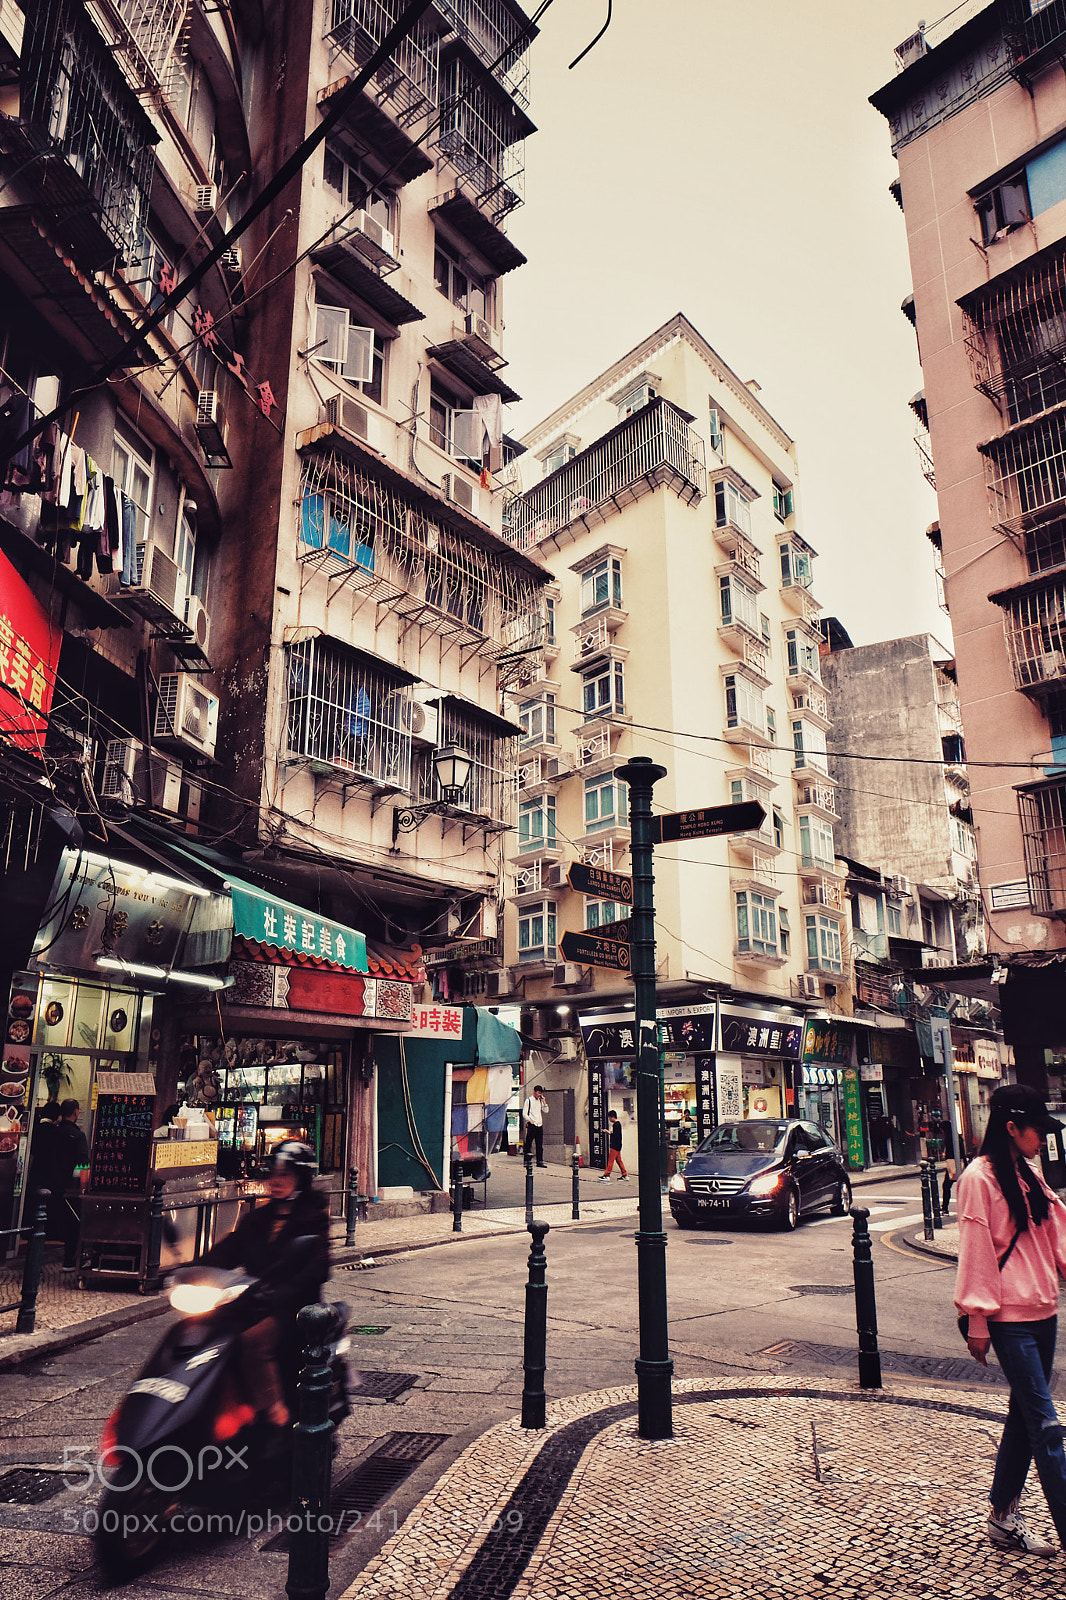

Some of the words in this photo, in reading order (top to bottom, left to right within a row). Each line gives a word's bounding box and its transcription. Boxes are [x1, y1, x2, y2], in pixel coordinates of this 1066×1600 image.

[711, 819, 724, 827] KUNG
[693, 1006, 713, 1014] EXPORT
[746, 1026, 780, 1050] 澳洲皇
[846, 1083, 863, 1164] 澳門地道小吃
[697, 1199, 730, 1208] MN-74-11
